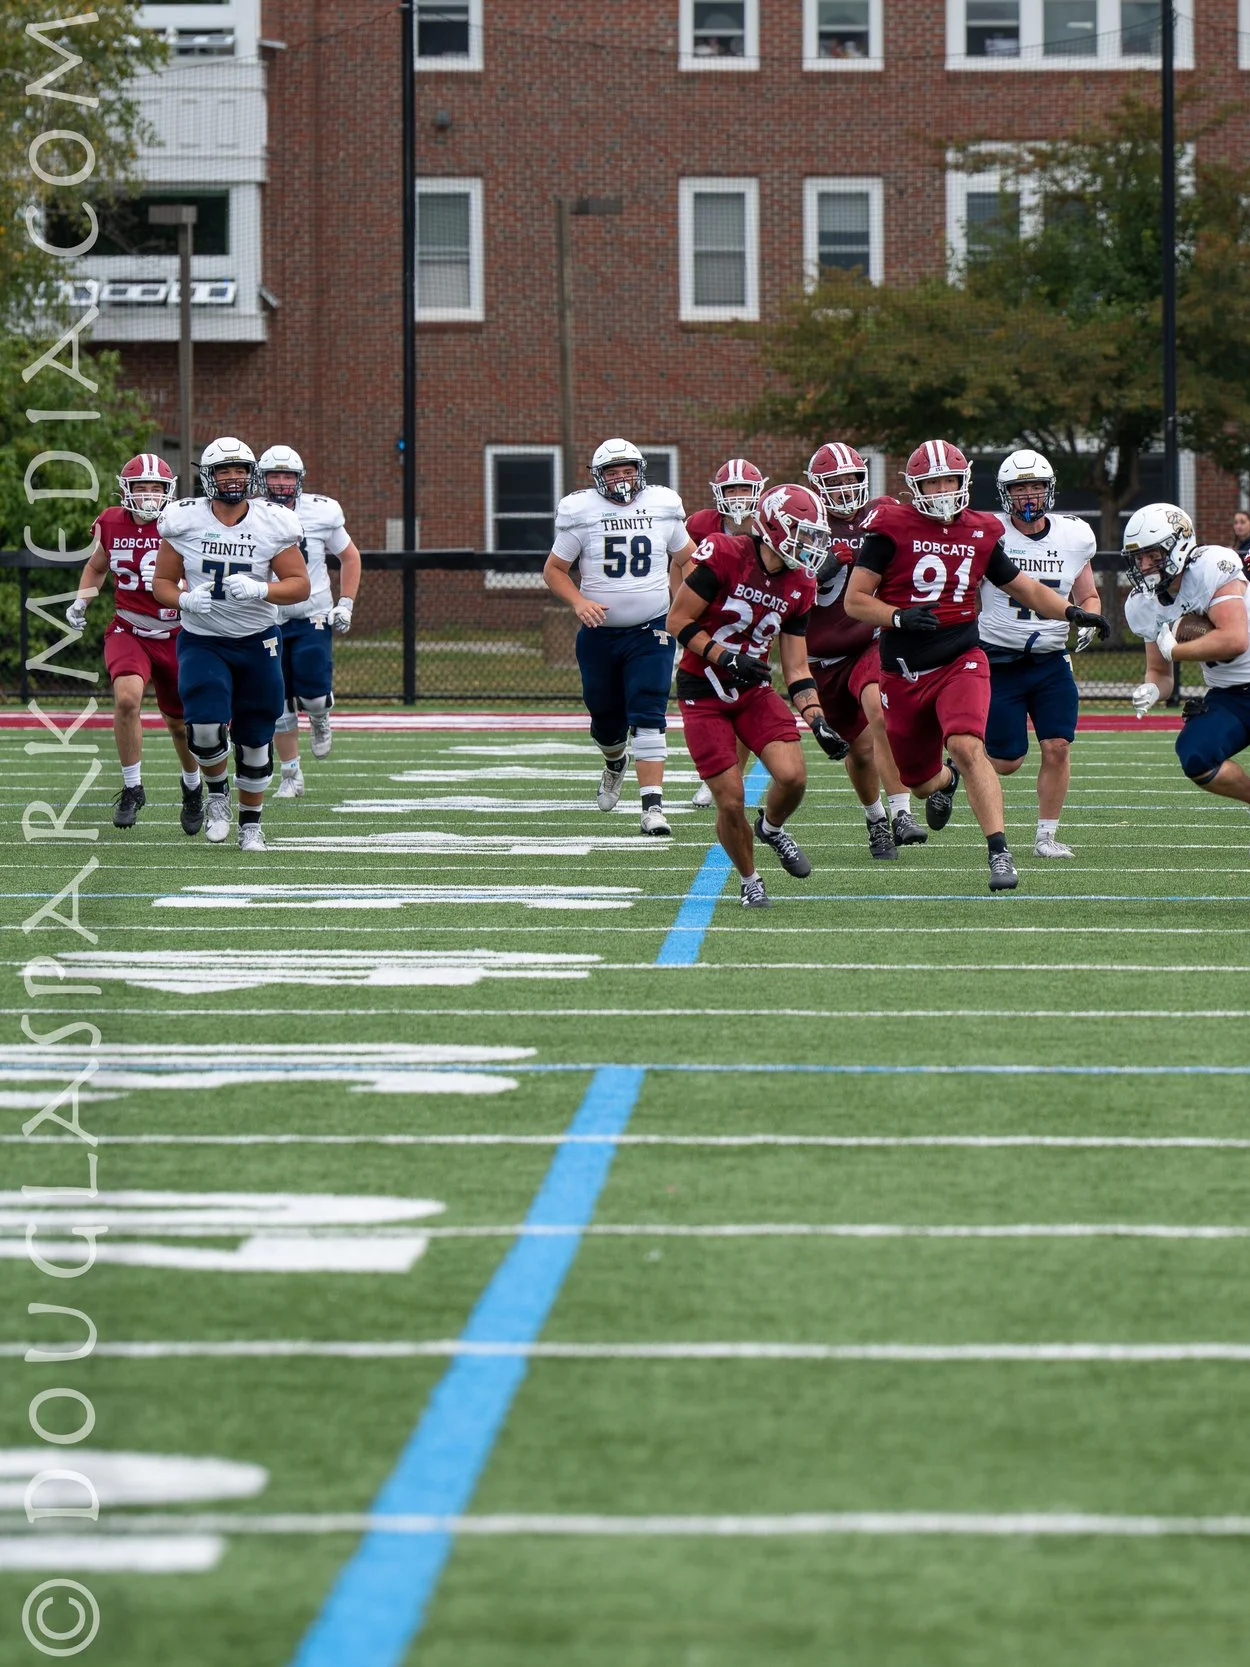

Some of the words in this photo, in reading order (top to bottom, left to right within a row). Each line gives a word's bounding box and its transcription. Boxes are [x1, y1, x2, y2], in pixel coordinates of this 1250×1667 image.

[601, 517, 653, 531] TRINITY
[201, 541, 256, 558] TRINITY
[603, 535, 652, 579] 58
[691, 538, 715, 561] 29
[912, 540, 976, 557] BOBCATS
[1009, 557, 1065, 573] TRINITY
[910, 554, 973, 603] 91
[734, 583, 790, 614] BOBCATS
[711, 595, 782, 659] 29
